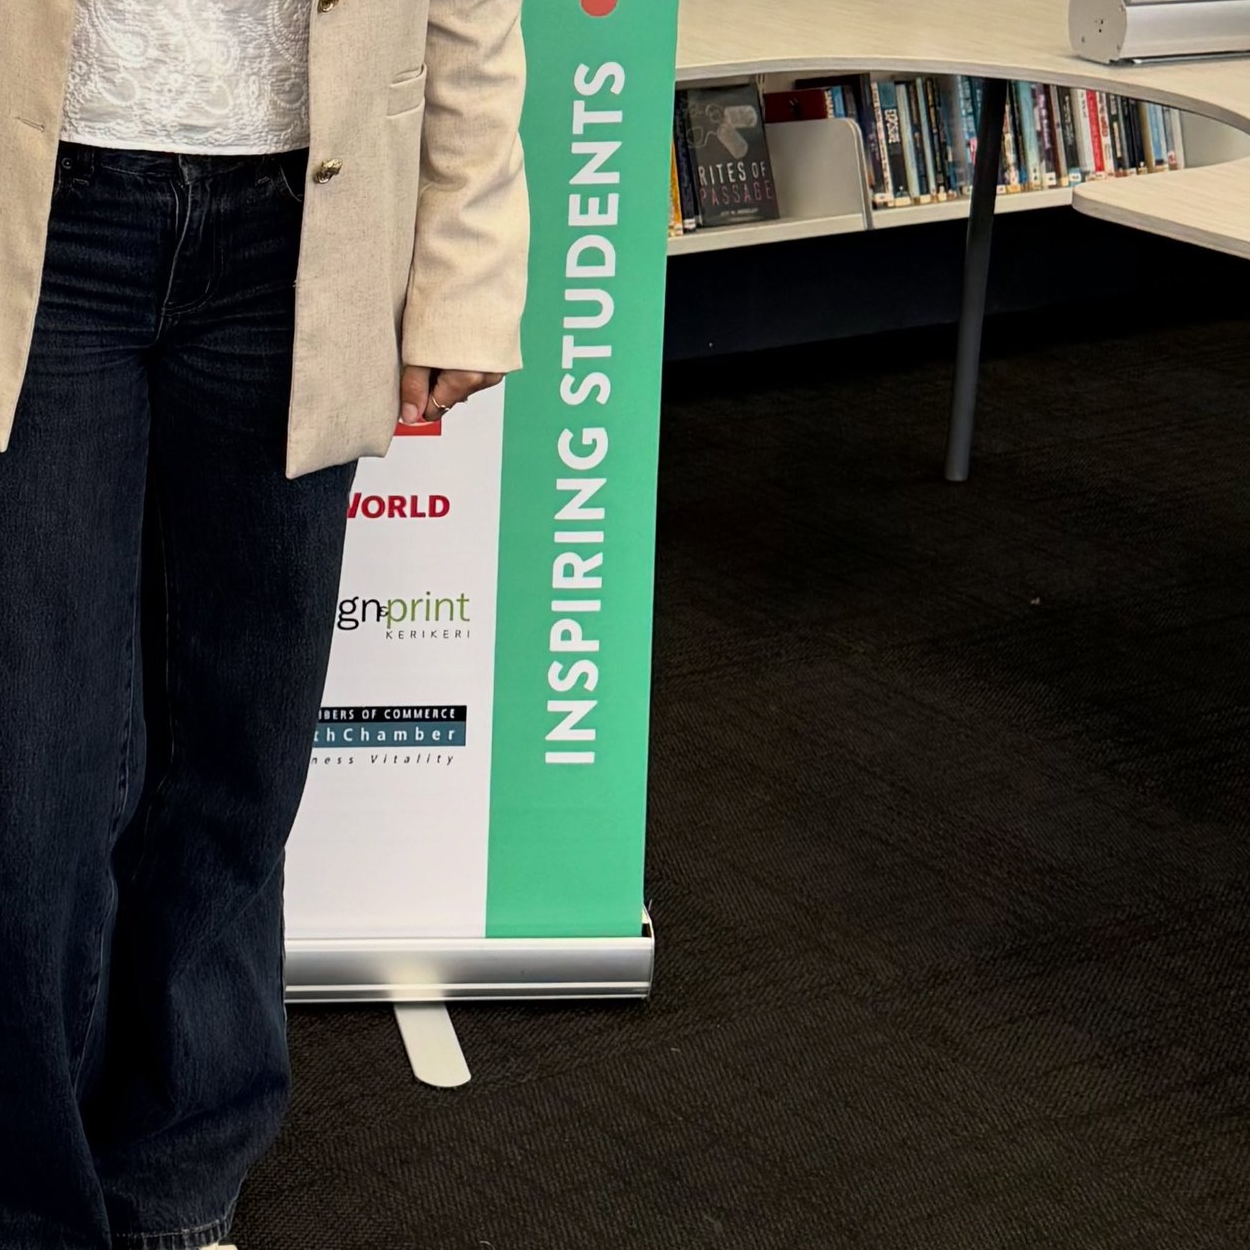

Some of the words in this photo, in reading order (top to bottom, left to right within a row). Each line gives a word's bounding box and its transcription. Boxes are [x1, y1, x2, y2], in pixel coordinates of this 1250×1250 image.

[698, 161, 747, 186] RITES
[751, 161, 766, 179] OF
[700, 180, 773, 206] PASSAGE
[561, 61, 626, 406] STUDENTS
[545, 427, 609, 764] INSPIRING
[386, 630, 471, 639] KERIKERI
[362, 709, 377, 719] OF
[384, 708, 456, 719] COMMERCE
[370, 753, 454, 765] Vitality
